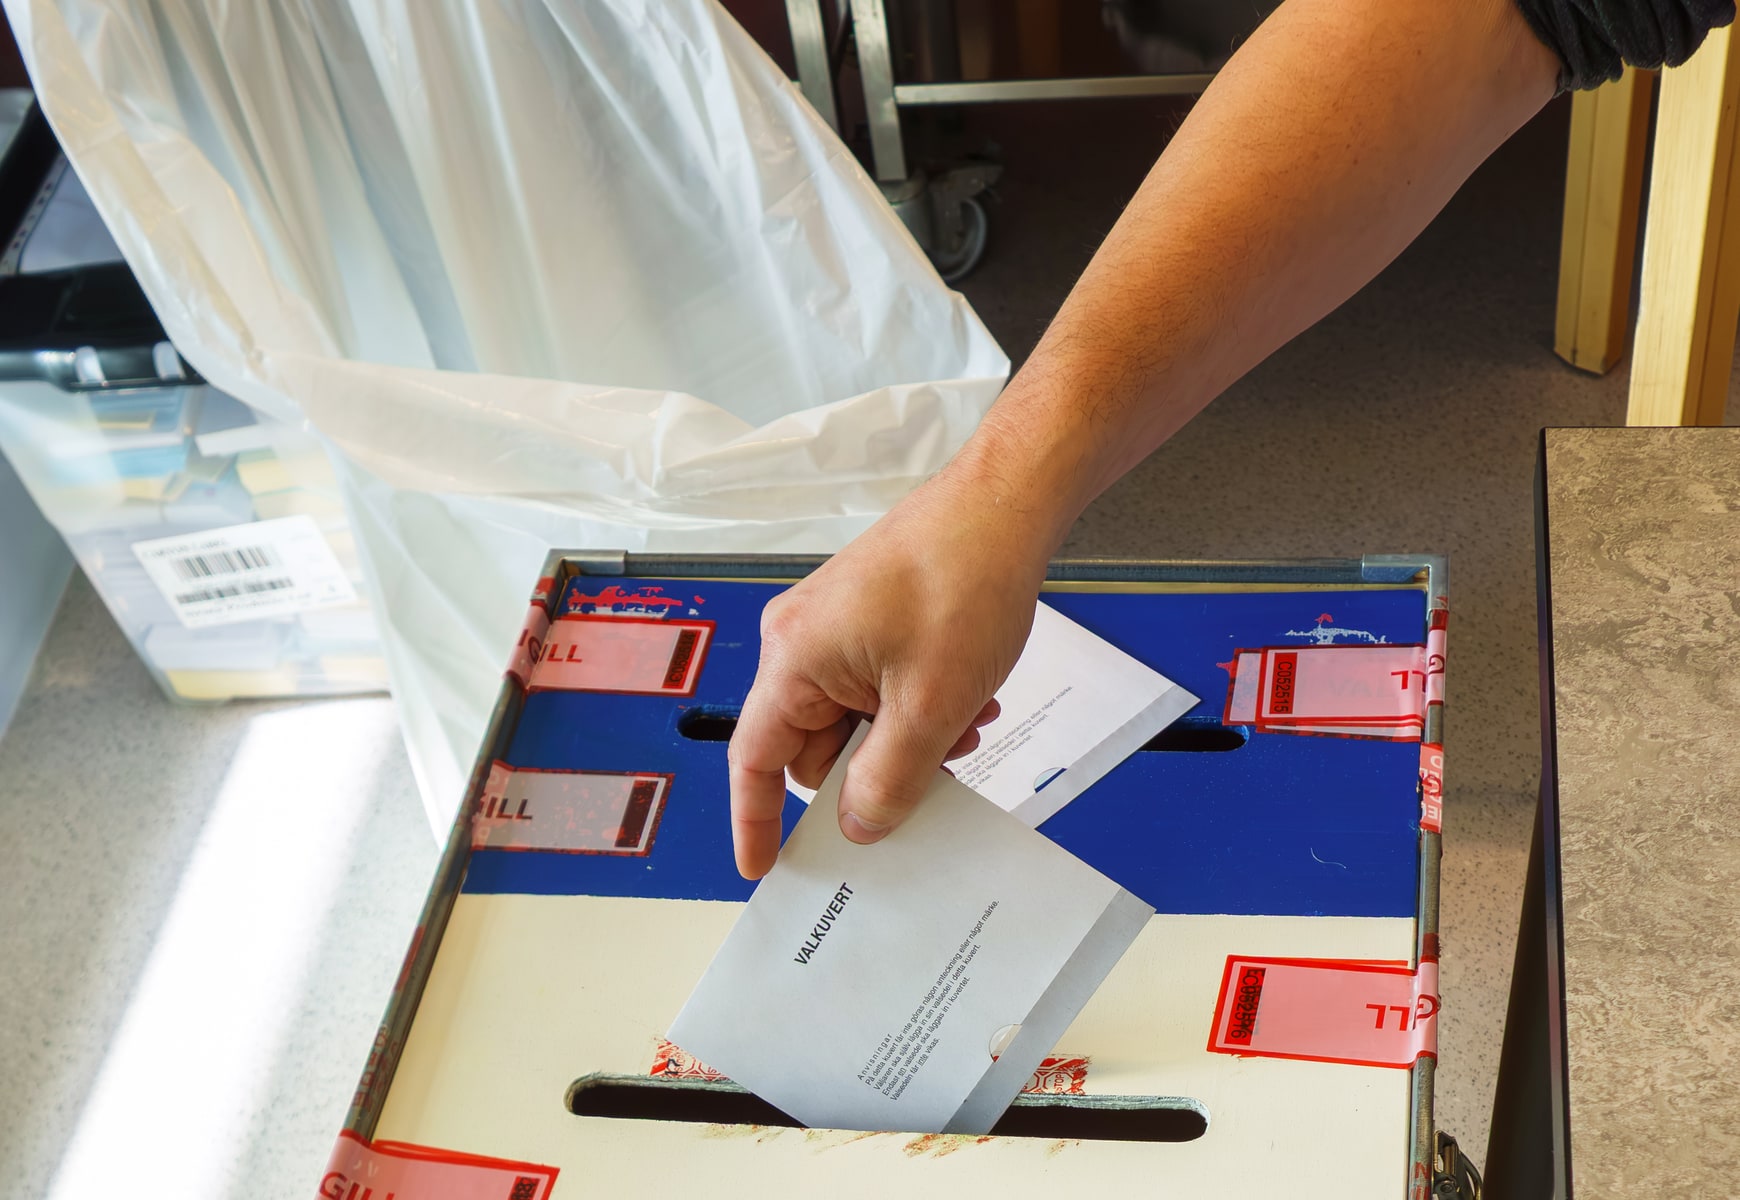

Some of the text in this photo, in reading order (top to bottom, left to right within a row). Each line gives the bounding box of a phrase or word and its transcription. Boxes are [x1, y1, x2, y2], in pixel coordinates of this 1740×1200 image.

[1274, 661, 1293, 713] C052515
[794, 882, 854, 964] VALKUVERT
[872, 1061, 886, 1077] detta
[881, 1042, 899, 1062] kuvert
[902, 1022, 913, 1035] inte
[910, 1004, 925, 1024] göras
[922, 985, 939, 1006] någon
[935, 952, 963, 987] anteckning
[958, 938, 972, 954] eller
[968, 920, 985, 940] något
[981, 900, 1000, 922] märke.
[872, 1067, 894, 1090] Väljaren
[899, 1041, 911, 1057] själv
[907, 1025, 924, 1043] lägga
[931, 982, 953, 1009] valsedel
[951, 964, 966, 981] detta
[962, 944, 981, 965] kuvert.
[857, 1033, 893, 1081] Anvisningar
[881, 1075, 901, 1097] Endast
[903, 1042, 923, 1068] valsedel
[926, 1012, 945, 1033] läggas
[947, 976, 971, 1003] kuvertet.
[889, 1073, 914, 1101] Valsedeln
[915, 1053, 929, 1067] inte
[924, 1037, 940, 1054] vikas.
